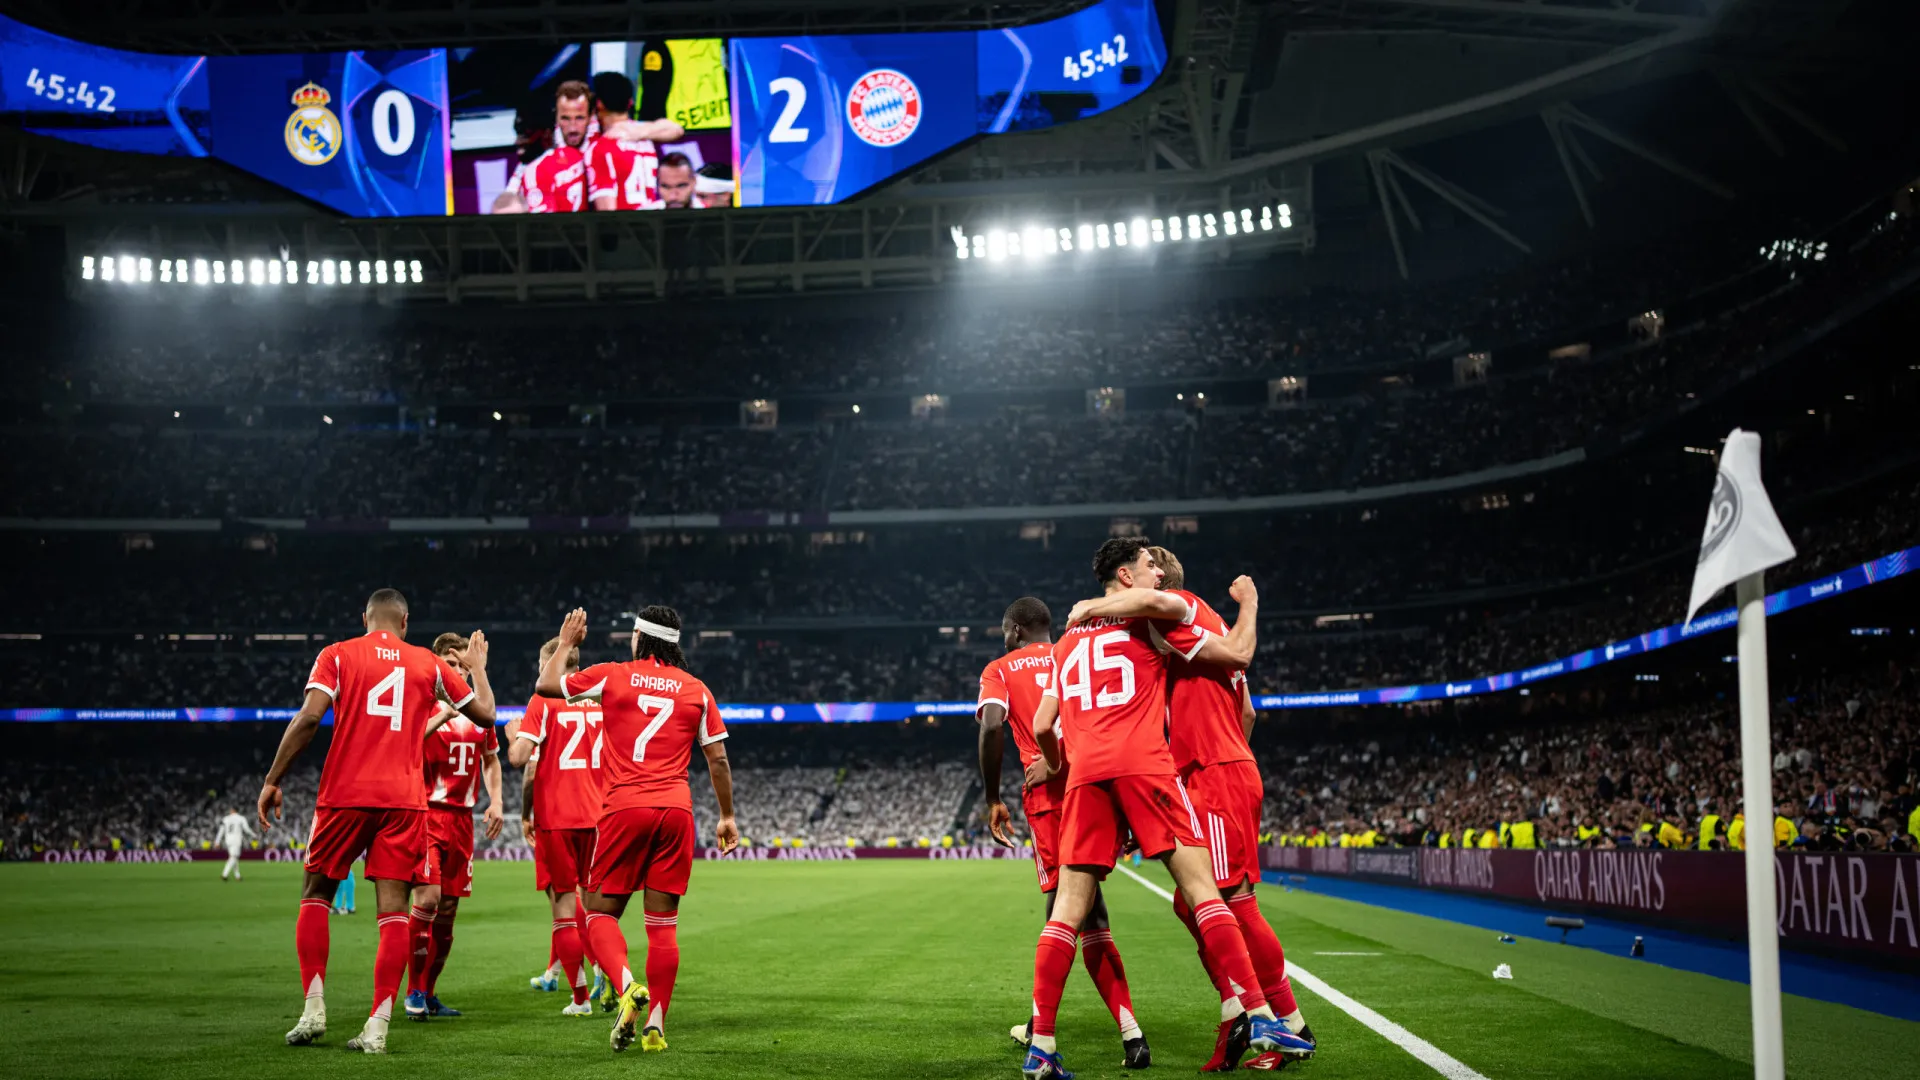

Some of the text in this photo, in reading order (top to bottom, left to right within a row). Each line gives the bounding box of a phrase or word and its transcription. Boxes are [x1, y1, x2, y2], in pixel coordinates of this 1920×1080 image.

[1063, 34, 1129, 81] 45:42
[26, 68, 116, 113] 45:42
[768, 77, 810, 143] 2
[371, 89, 416, 157] 0
[375, 646, 400, 661] TAH
[1059, 629, 1136, 711] 45
[366, 666, 406, 731] 4
[630, 673, 683, 694] GNABRY
[557, 711, 604, 770] 27
[633, 694, 675, 762] 7
[448, 742, 476, 776] T
[44, 849, 193, 863] QATAR AIRWAYS
[704, 847, 857, 861] QATAR AIRWAYS
[929, 846, 994, 861] QATAR
[1534, 851, 1665, 911] QATAR AIRWAYS
